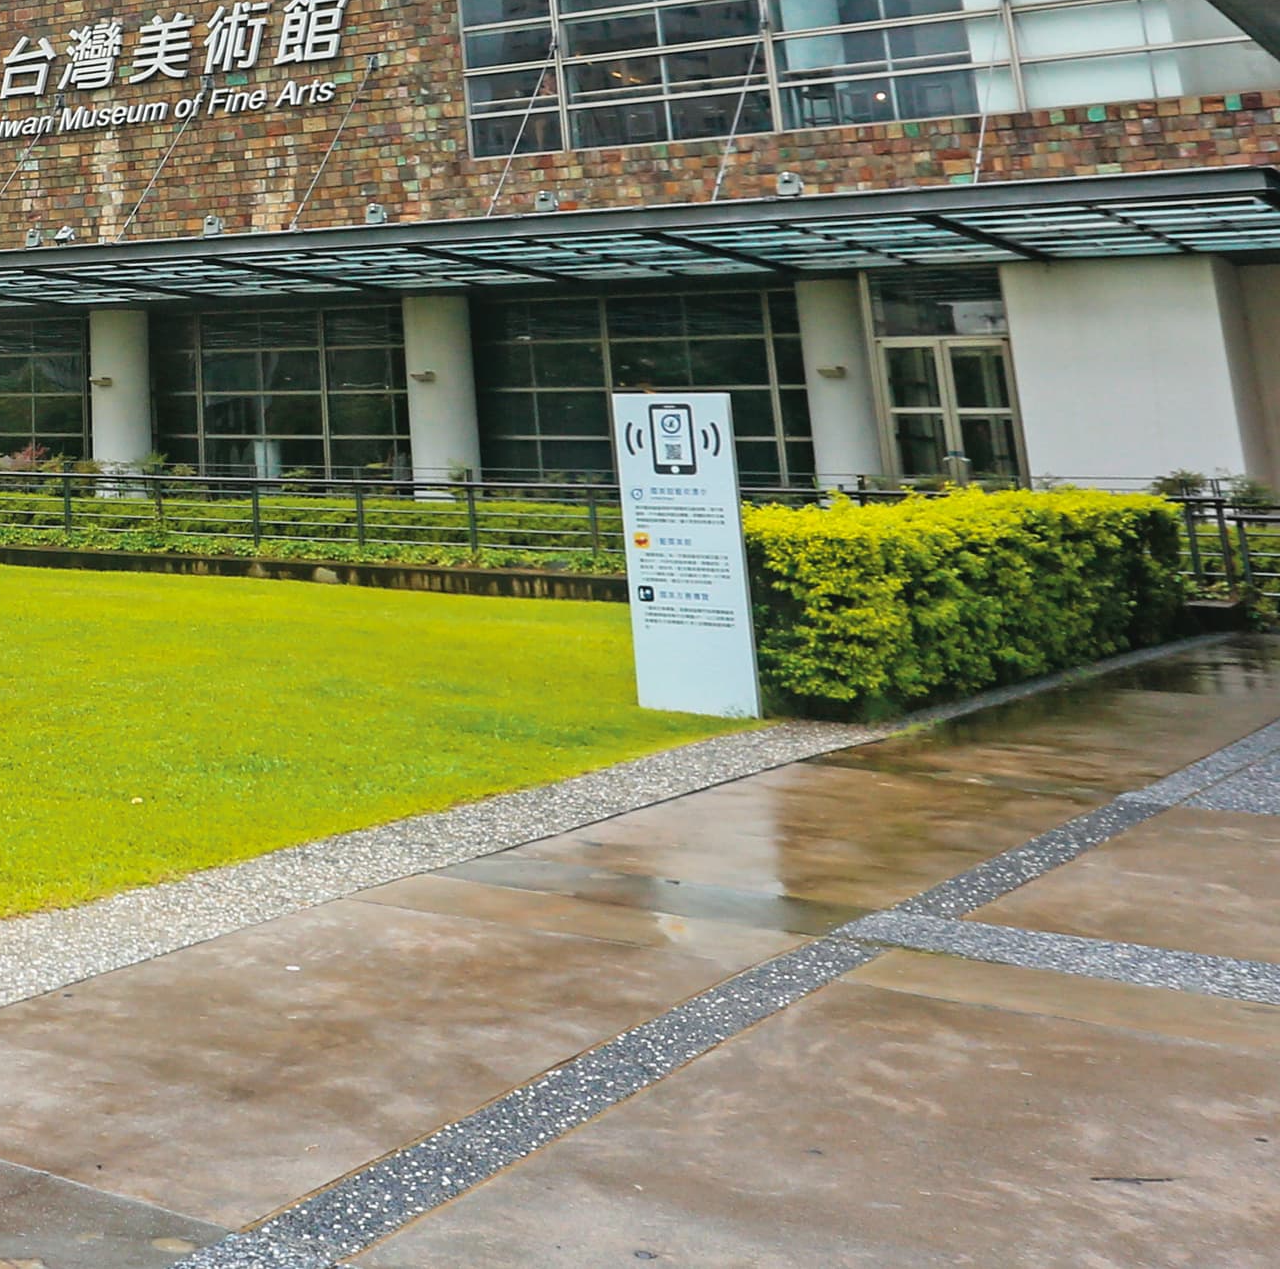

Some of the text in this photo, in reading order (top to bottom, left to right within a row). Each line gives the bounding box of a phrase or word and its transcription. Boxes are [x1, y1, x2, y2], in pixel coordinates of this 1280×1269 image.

[58, 98, 169, 132] Museum
[174, 92, 204, 119] of
[207, 87, 268, 116] Fine
[274, 79, 337, 108] Arts
